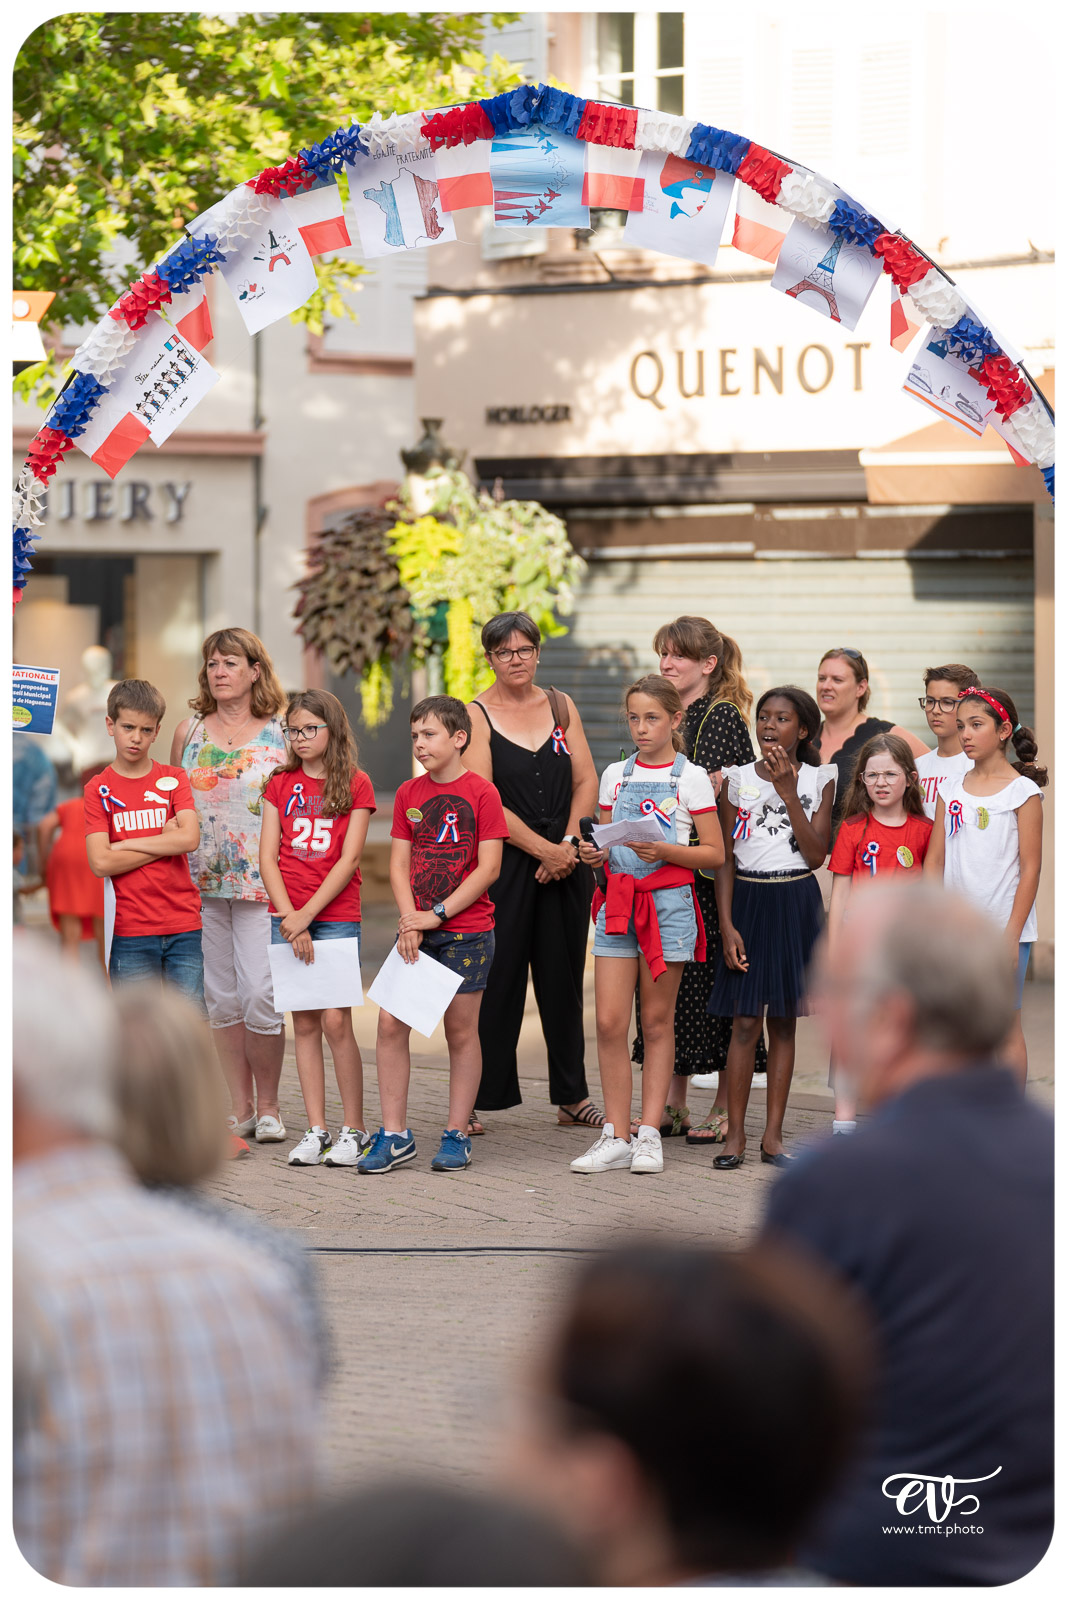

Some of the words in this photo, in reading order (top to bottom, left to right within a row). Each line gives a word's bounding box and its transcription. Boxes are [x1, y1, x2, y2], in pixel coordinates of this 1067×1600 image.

[630, 341, 871, 410] QUENOT
[485, 404, 572, 426] HORLOGER
[20, 479, 192, 525] IERY
[23, 691, 51, 699] Municipal
[114, 808, 167, 832] PUMA
[291, 817, 334, 853] 25
